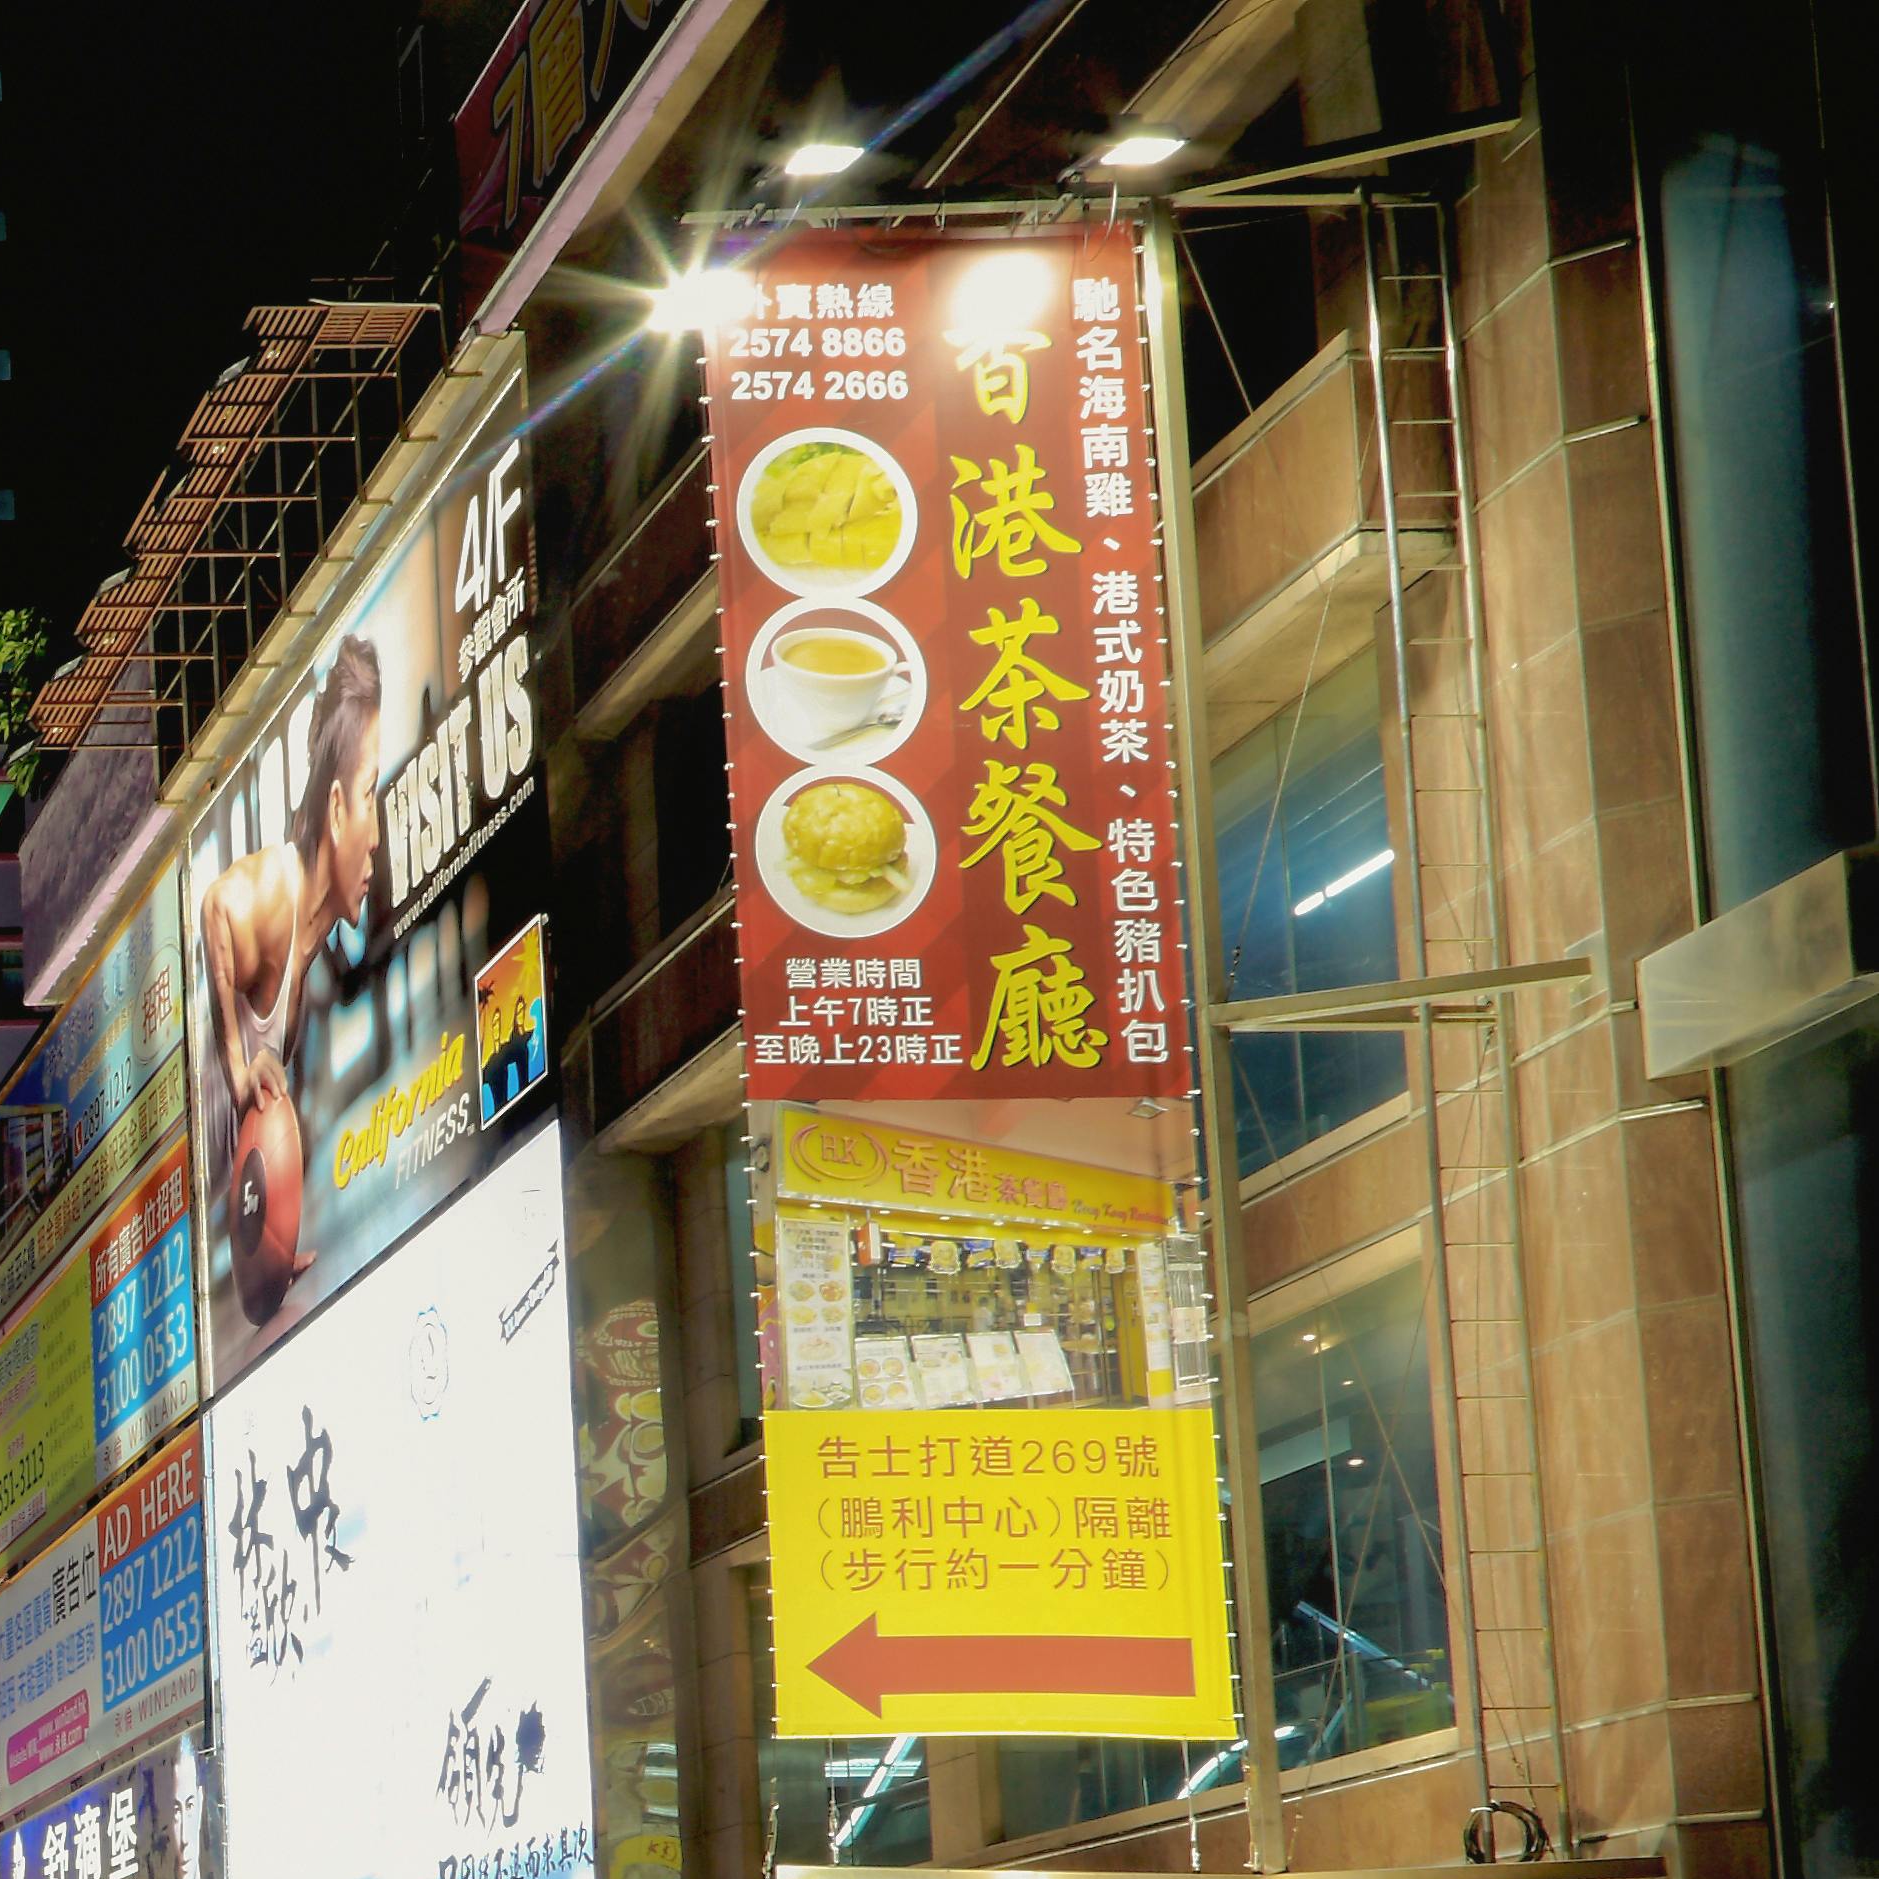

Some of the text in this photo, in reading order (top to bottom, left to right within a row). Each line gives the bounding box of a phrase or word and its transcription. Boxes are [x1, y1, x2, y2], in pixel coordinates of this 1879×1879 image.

[729, 326, 906, 358] 2574 8866
[731, 372, 909, 400] 2574 2666
[454, 438, 525, 615] 4/F
[385, 630, 533, 909] VISIT US
[778, 997, 935, 1030] 上午7時正
[785, 958, 922, 991] 營業時間
[753, 1033, 964, 1065] 至晚上23時正
[333, 1031, 467, 1191] California
[394, 1092, 471, 1191] FITNESS
[95, 1166, 183, 1298] 所有廣告位招租
[97, 1279, 137, 1365] 2897
[142, 1232, 186, 1320] 1212
[99, 1349, 139, 1429] 3100
[144, 1302, 188, 1386] 0553
[128, 1380, 188, 1450] WINLAND
[103, 1503, 132, 1568] AD
[141, 1448, 195, 1539] HERE
[817, 1435, 1161, 1479] 告士打道269號
[102, 1516, 199, 1635] 2897 1212
[104, 1627, 147, 1704] 3100
[151, 1592, 199, 1666] 0553
[138, 1675, 198, 1723] WINLAND
